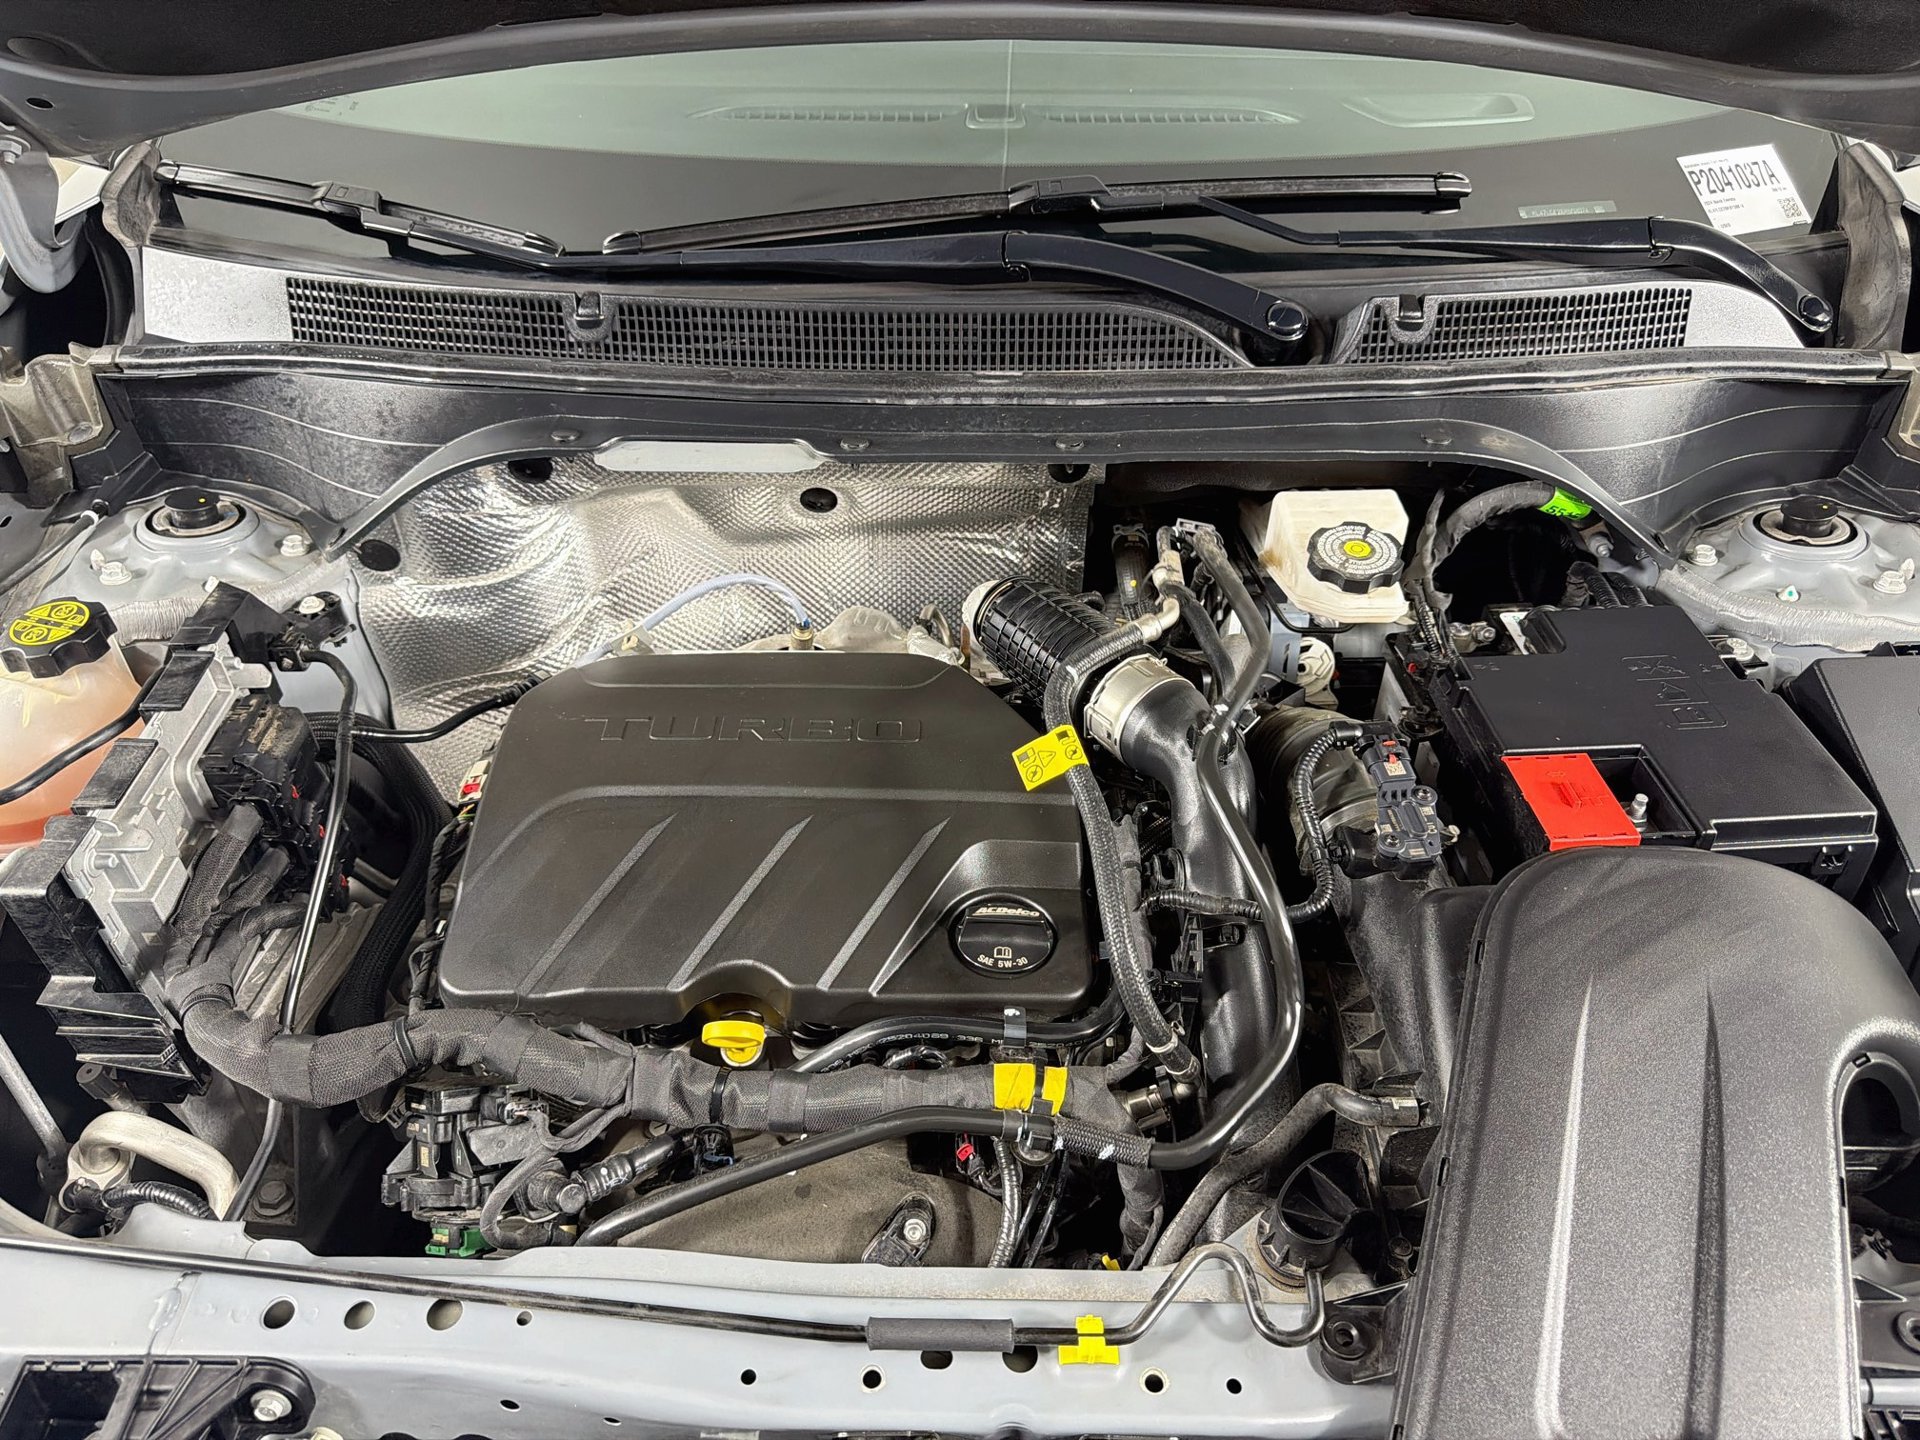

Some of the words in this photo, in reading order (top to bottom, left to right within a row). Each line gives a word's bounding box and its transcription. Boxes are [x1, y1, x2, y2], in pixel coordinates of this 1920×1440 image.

[1688, 160, 1780, 196] P2041037A
[585, 717, 922, 742] TURBO
[972, 907, 1040, 918] ACDelco
[977, 954, 995, 966] SAE
[997, 956, 1029, 968] 5W-30
